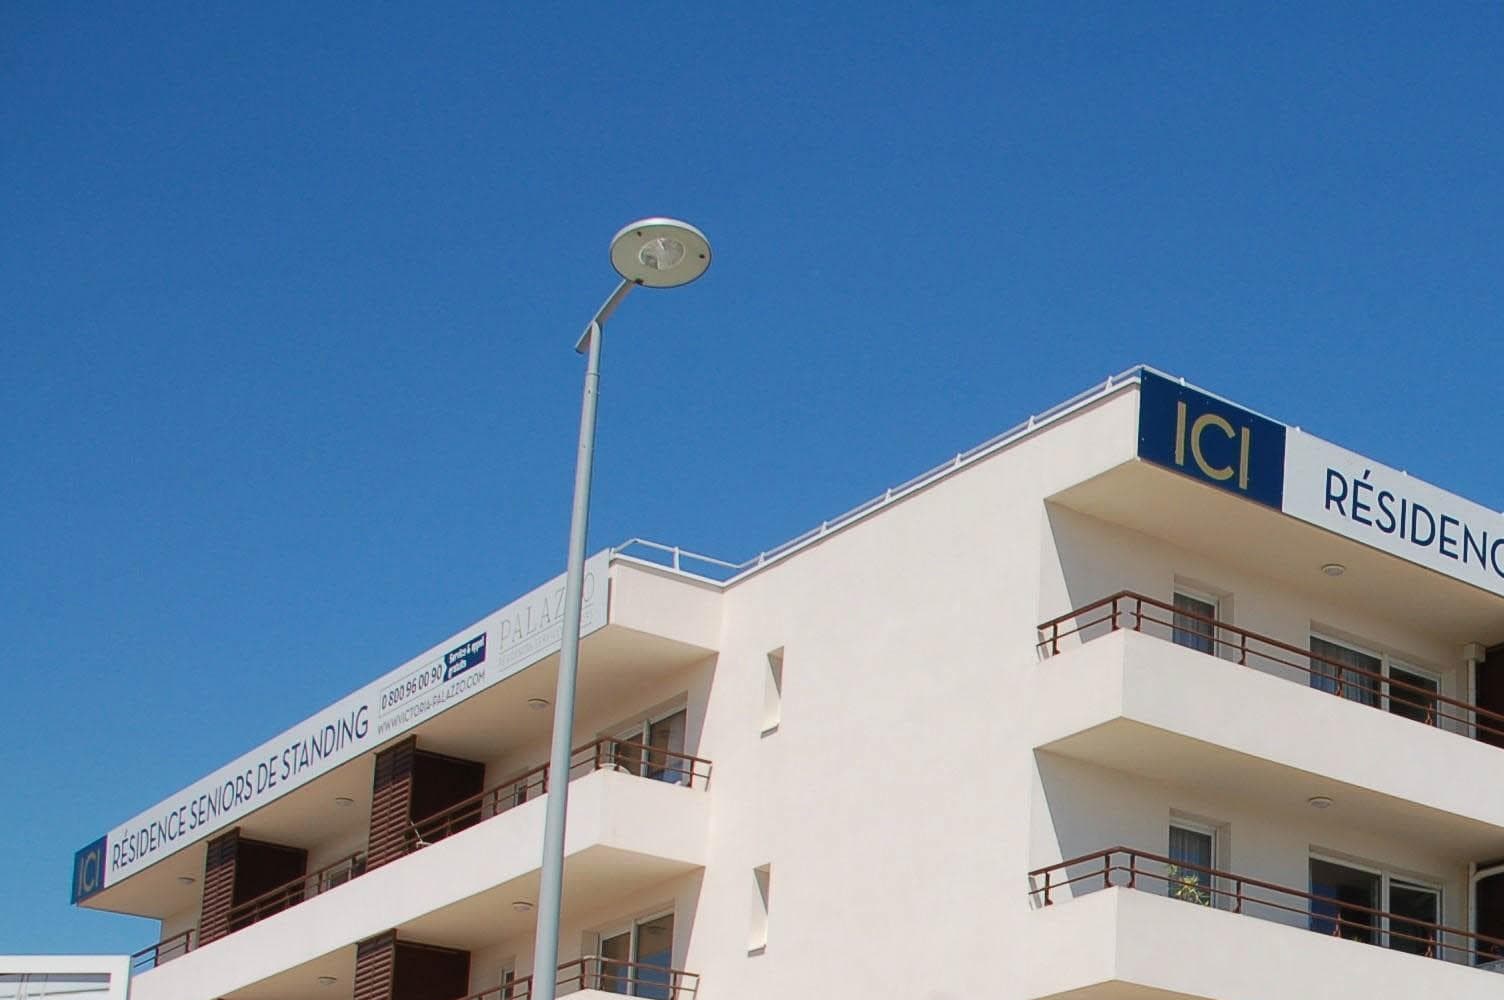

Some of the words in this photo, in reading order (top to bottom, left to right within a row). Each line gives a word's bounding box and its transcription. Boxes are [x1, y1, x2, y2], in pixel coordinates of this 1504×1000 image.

[1175, 401, 1250, 490] ICI
[500, 572, 595, 650] PALAZO
[112, 806, 187, 872] RÉSIDENCE
[189, 769, 253, 830] SENIORS
[257, 755, 278, 795] DE
[281, 705, 369, 781] STANDING
[77, 848, 100, 897] ICI
